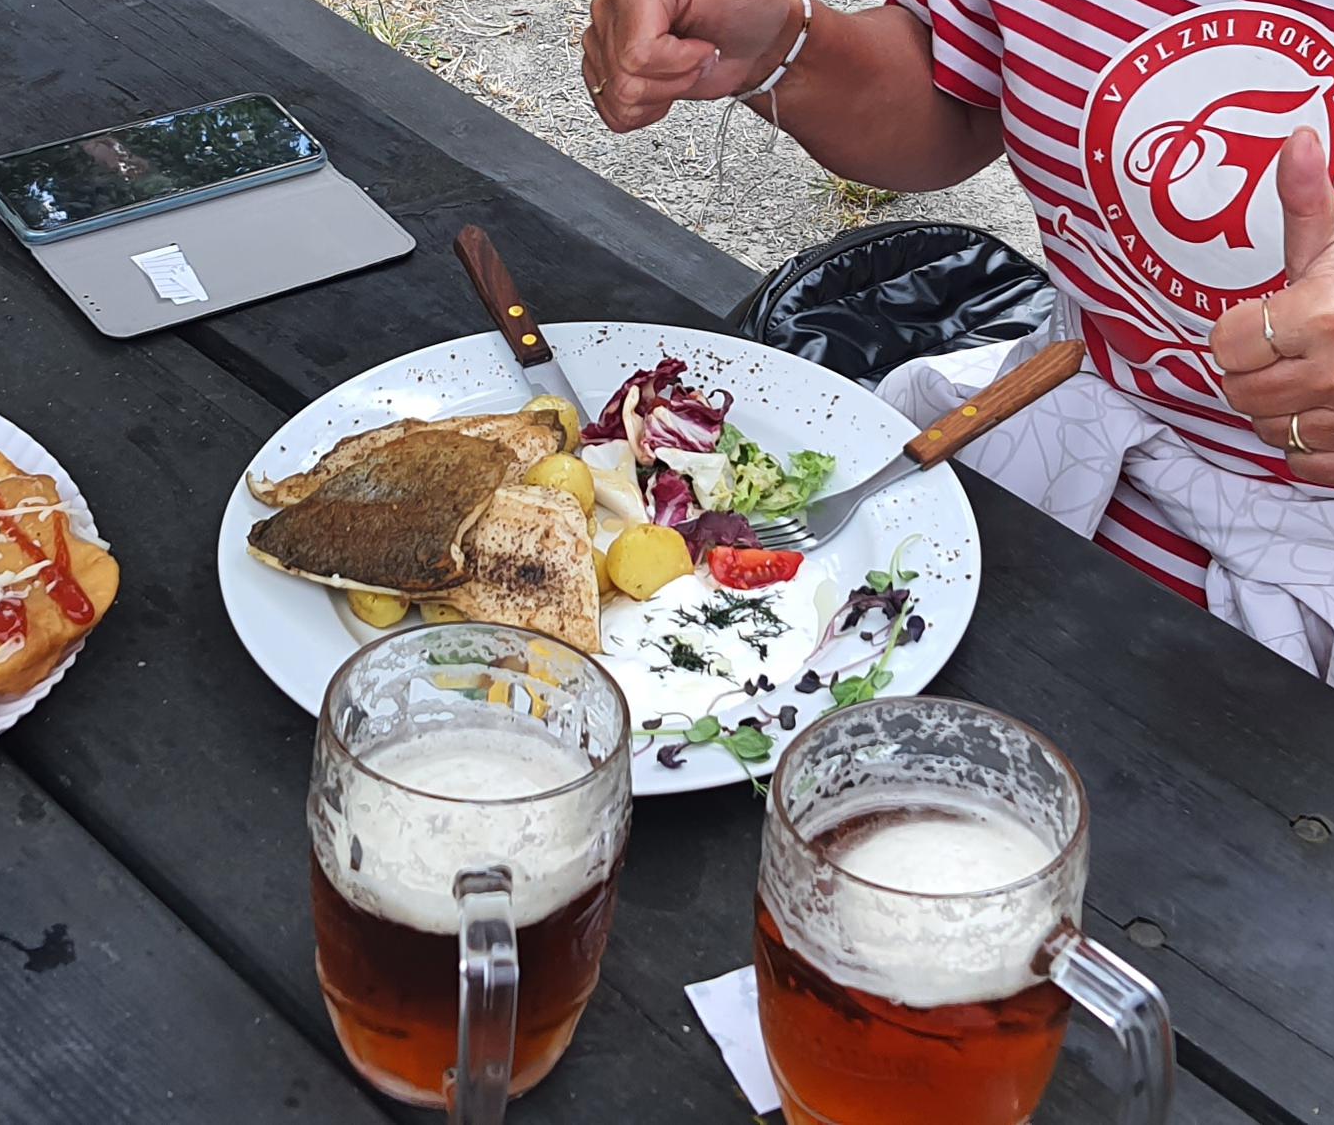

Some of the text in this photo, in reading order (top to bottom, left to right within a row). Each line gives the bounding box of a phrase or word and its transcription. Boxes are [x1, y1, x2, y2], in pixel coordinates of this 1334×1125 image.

[1102, 83, 1124, 104] V
[1131, 18, 1235, 76] PLZNI
[1255, 19, 1334, 73] ROKU
[1105, 203, 1291, 315] GAMBRI
